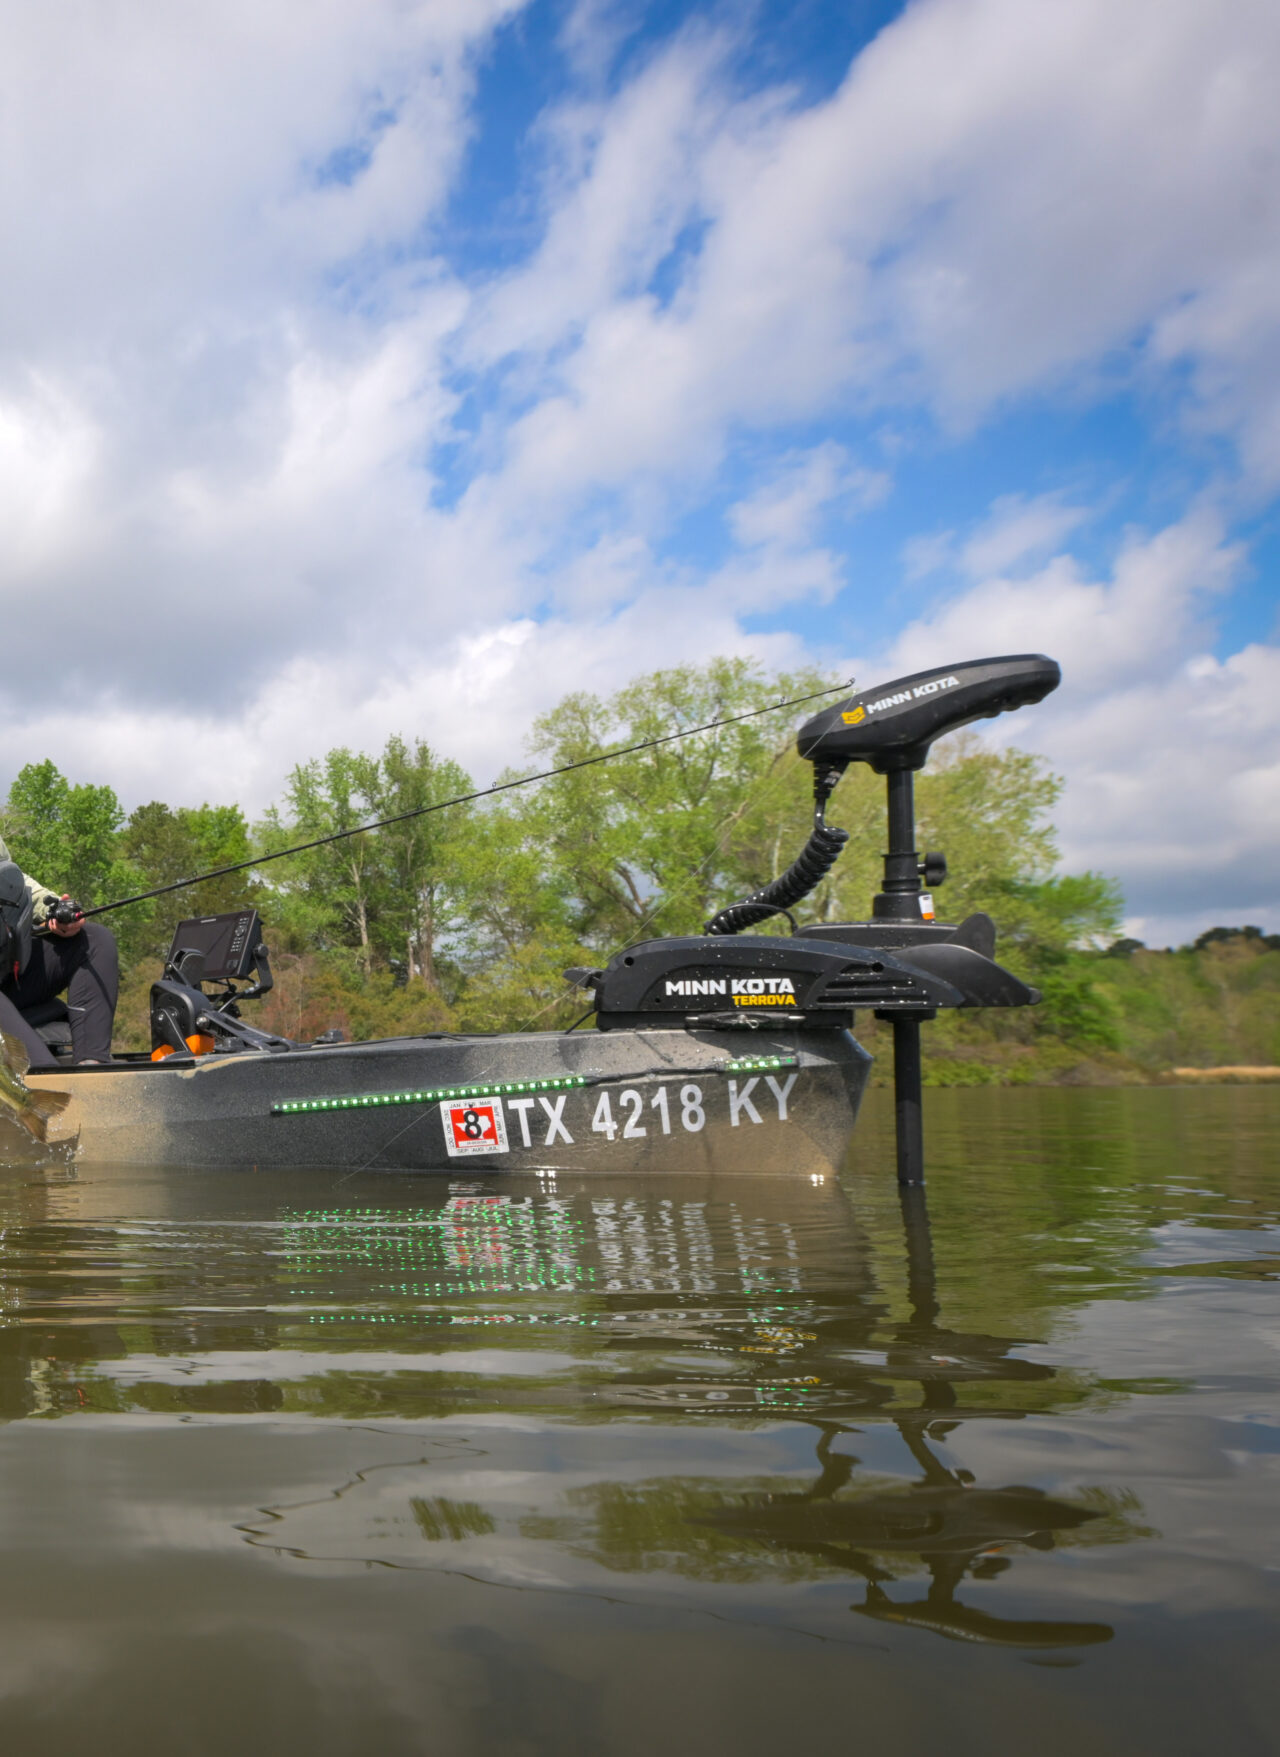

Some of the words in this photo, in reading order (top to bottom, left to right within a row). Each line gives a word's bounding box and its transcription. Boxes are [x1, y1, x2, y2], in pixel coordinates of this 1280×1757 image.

[866, 690, 912, 714] MINN
[912, 675, 960, 698] KOTA
[665, 979, 727, 996] MINN
[731, 978, 796, 994] KOTA
[732, 994, 797, 1006] TERROVA
[464, 1110, 482, 1139] 8
[508, 1095, 574, 1147] TX
[591, 1084, 706, 1141] 4218
[728, 1073, 798, 1127] KY
